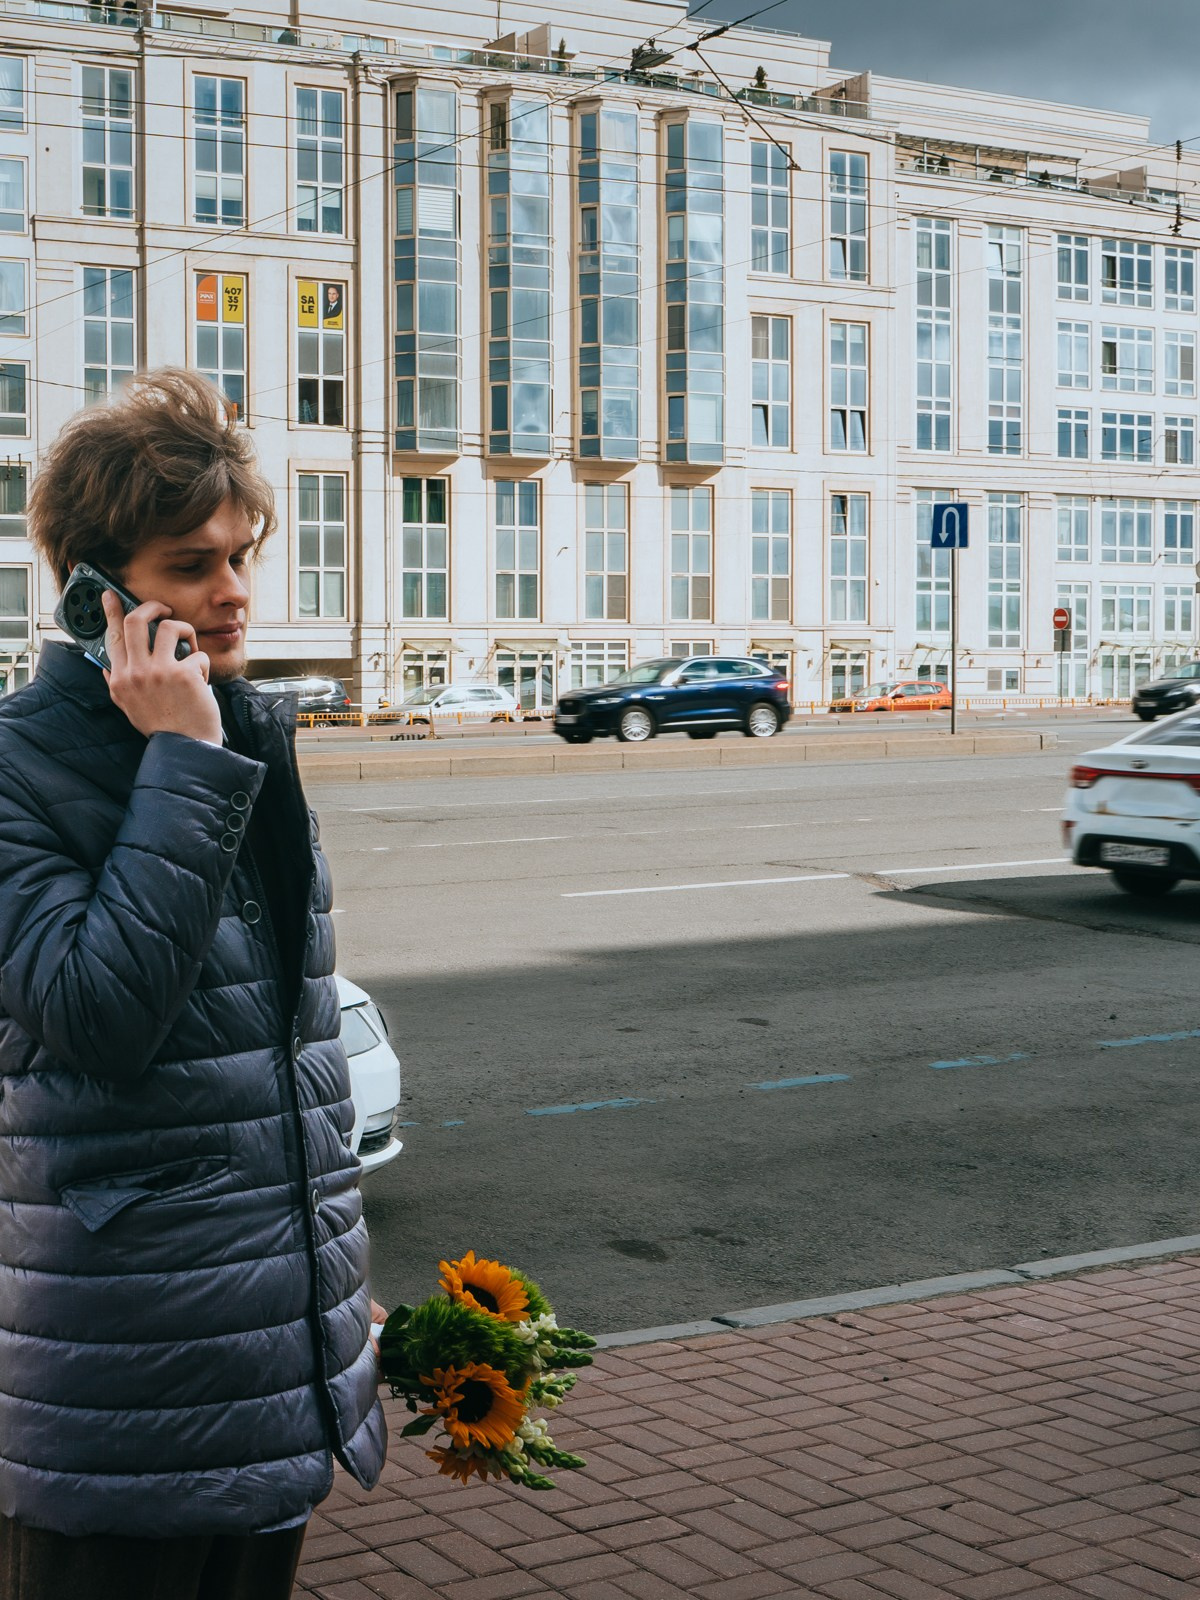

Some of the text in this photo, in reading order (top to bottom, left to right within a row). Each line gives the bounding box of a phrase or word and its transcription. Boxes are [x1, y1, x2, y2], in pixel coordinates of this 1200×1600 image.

[224, 287, 242, 295] 407
[227, 296, 239, 304] 35
[301, 295, 315, 305] SA
[228, 304, 238, 312] 77
[301, 305, 315, 314] LE
